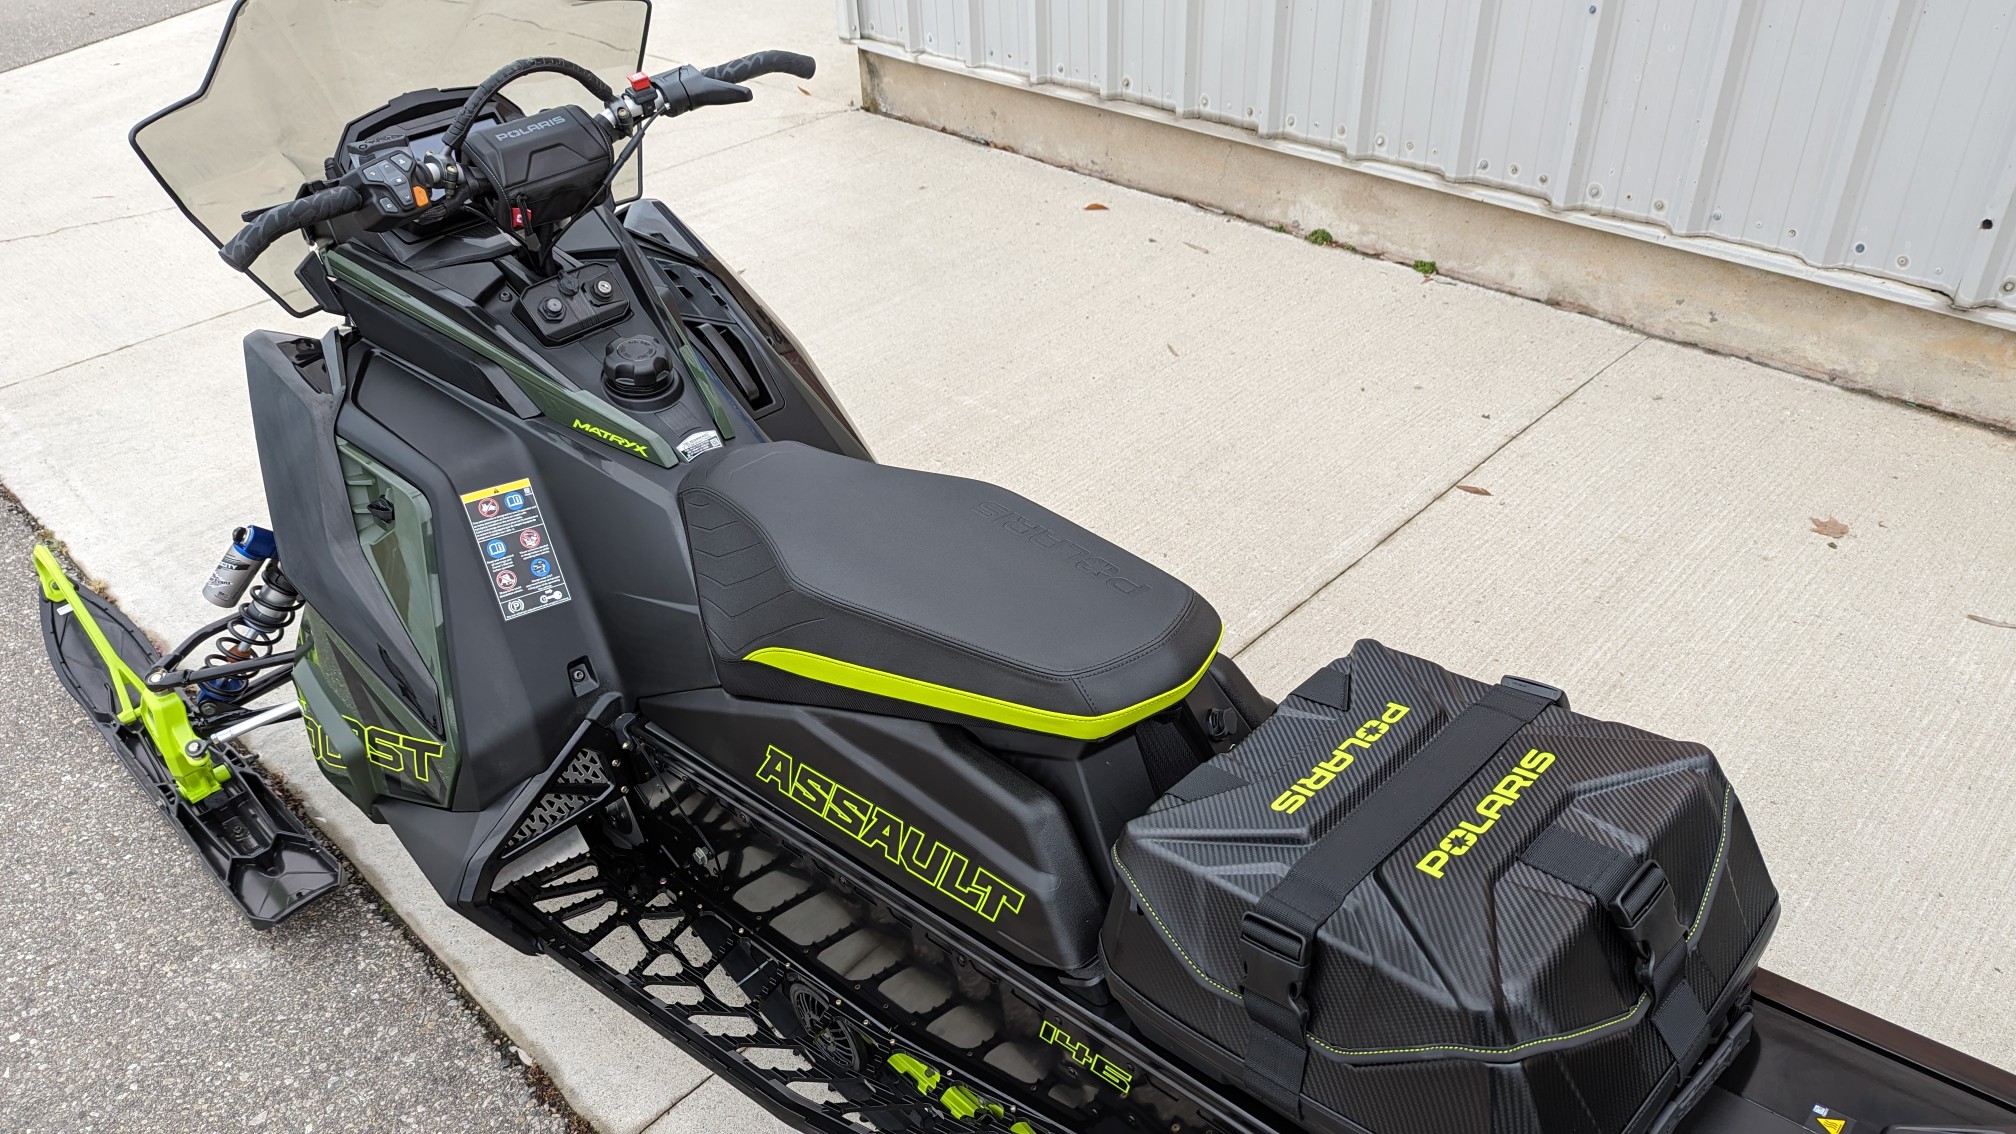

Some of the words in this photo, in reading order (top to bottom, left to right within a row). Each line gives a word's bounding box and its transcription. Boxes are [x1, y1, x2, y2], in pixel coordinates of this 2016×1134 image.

[495, 115, 566, 142] POLARIS
[572, 418, 649, 458] MATRYX
[971, 500, 1153, 597] POLARIS
[1269, 700, 1410, 815] POLARIS
[755, 744, 1026, 923] ASSAULT
[1415, 747, 1556, 880] POLARIS
[1039, 1020, 1133, 1094] 146
